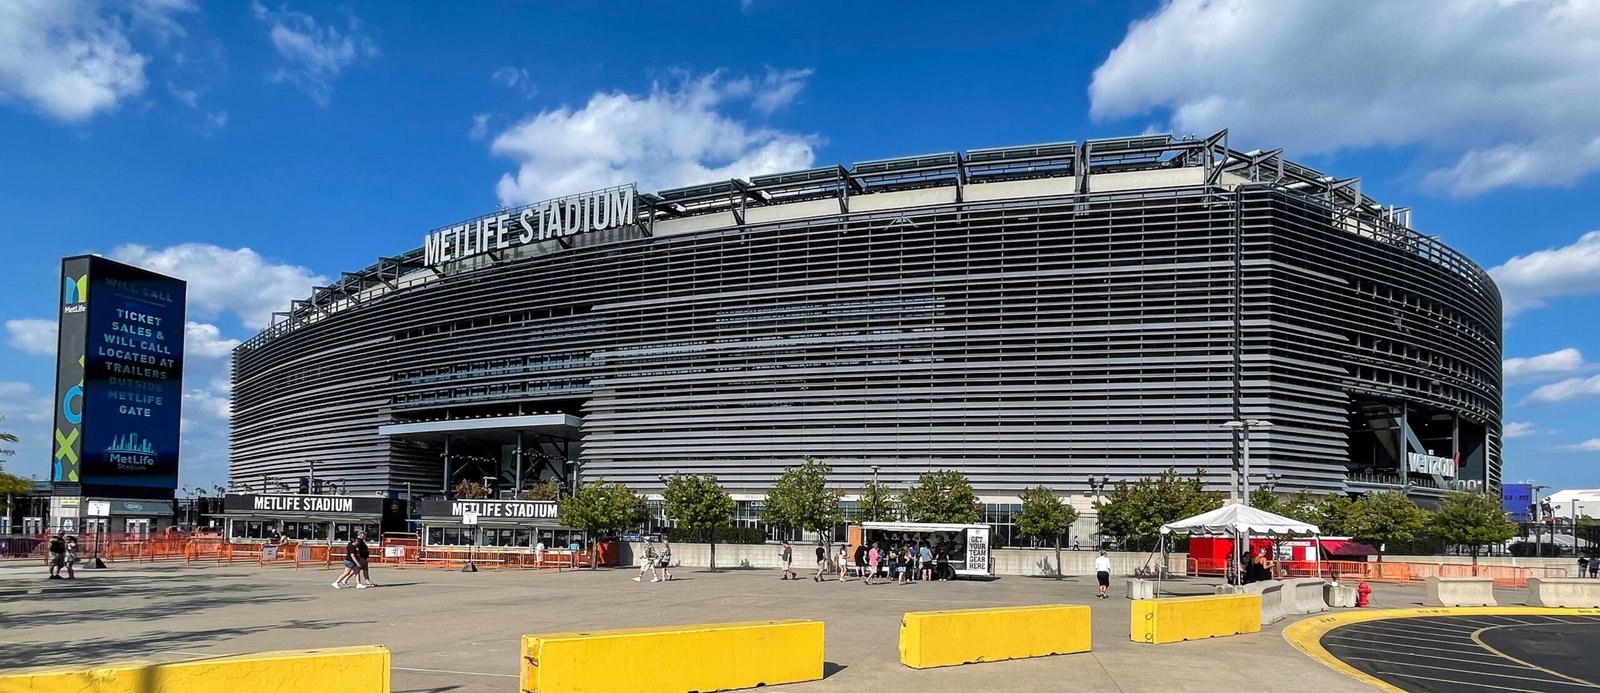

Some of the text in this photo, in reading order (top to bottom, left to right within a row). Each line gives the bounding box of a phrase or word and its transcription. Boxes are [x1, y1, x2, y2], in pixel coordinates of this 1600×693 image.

[424, 186, 634, 267] METLIFE STADIUM
[105, 277, 173, 303] WILL CALL
[65, 304, 86, 314] MetLife
[117, 308, 162, 326] TICKET
[112, 321, 165, 340] SALES &
[104, 333, 171, 355] WILL CALL
[98, 346, 175, 368] LOCATED AT
[105, 361, 167, 380] TRAILERS
[109, 376, 163, 392] OUTSIDE
[108, 389, 163, 406] METLIFE
[119, 405, 152, 418] GATE
[109, 453, 155, 466] MetLife
[117, 462, 147, 471] Stadium
[1407, 449, 1455, 477] verizon
[254, 496, 353, 512] METLIFE STADIUM
[452, 502, 558, 518] METLIFE STADIUM
[969, 555, 986, 563] GEAR
[969, 562, 986, 570] HERE
